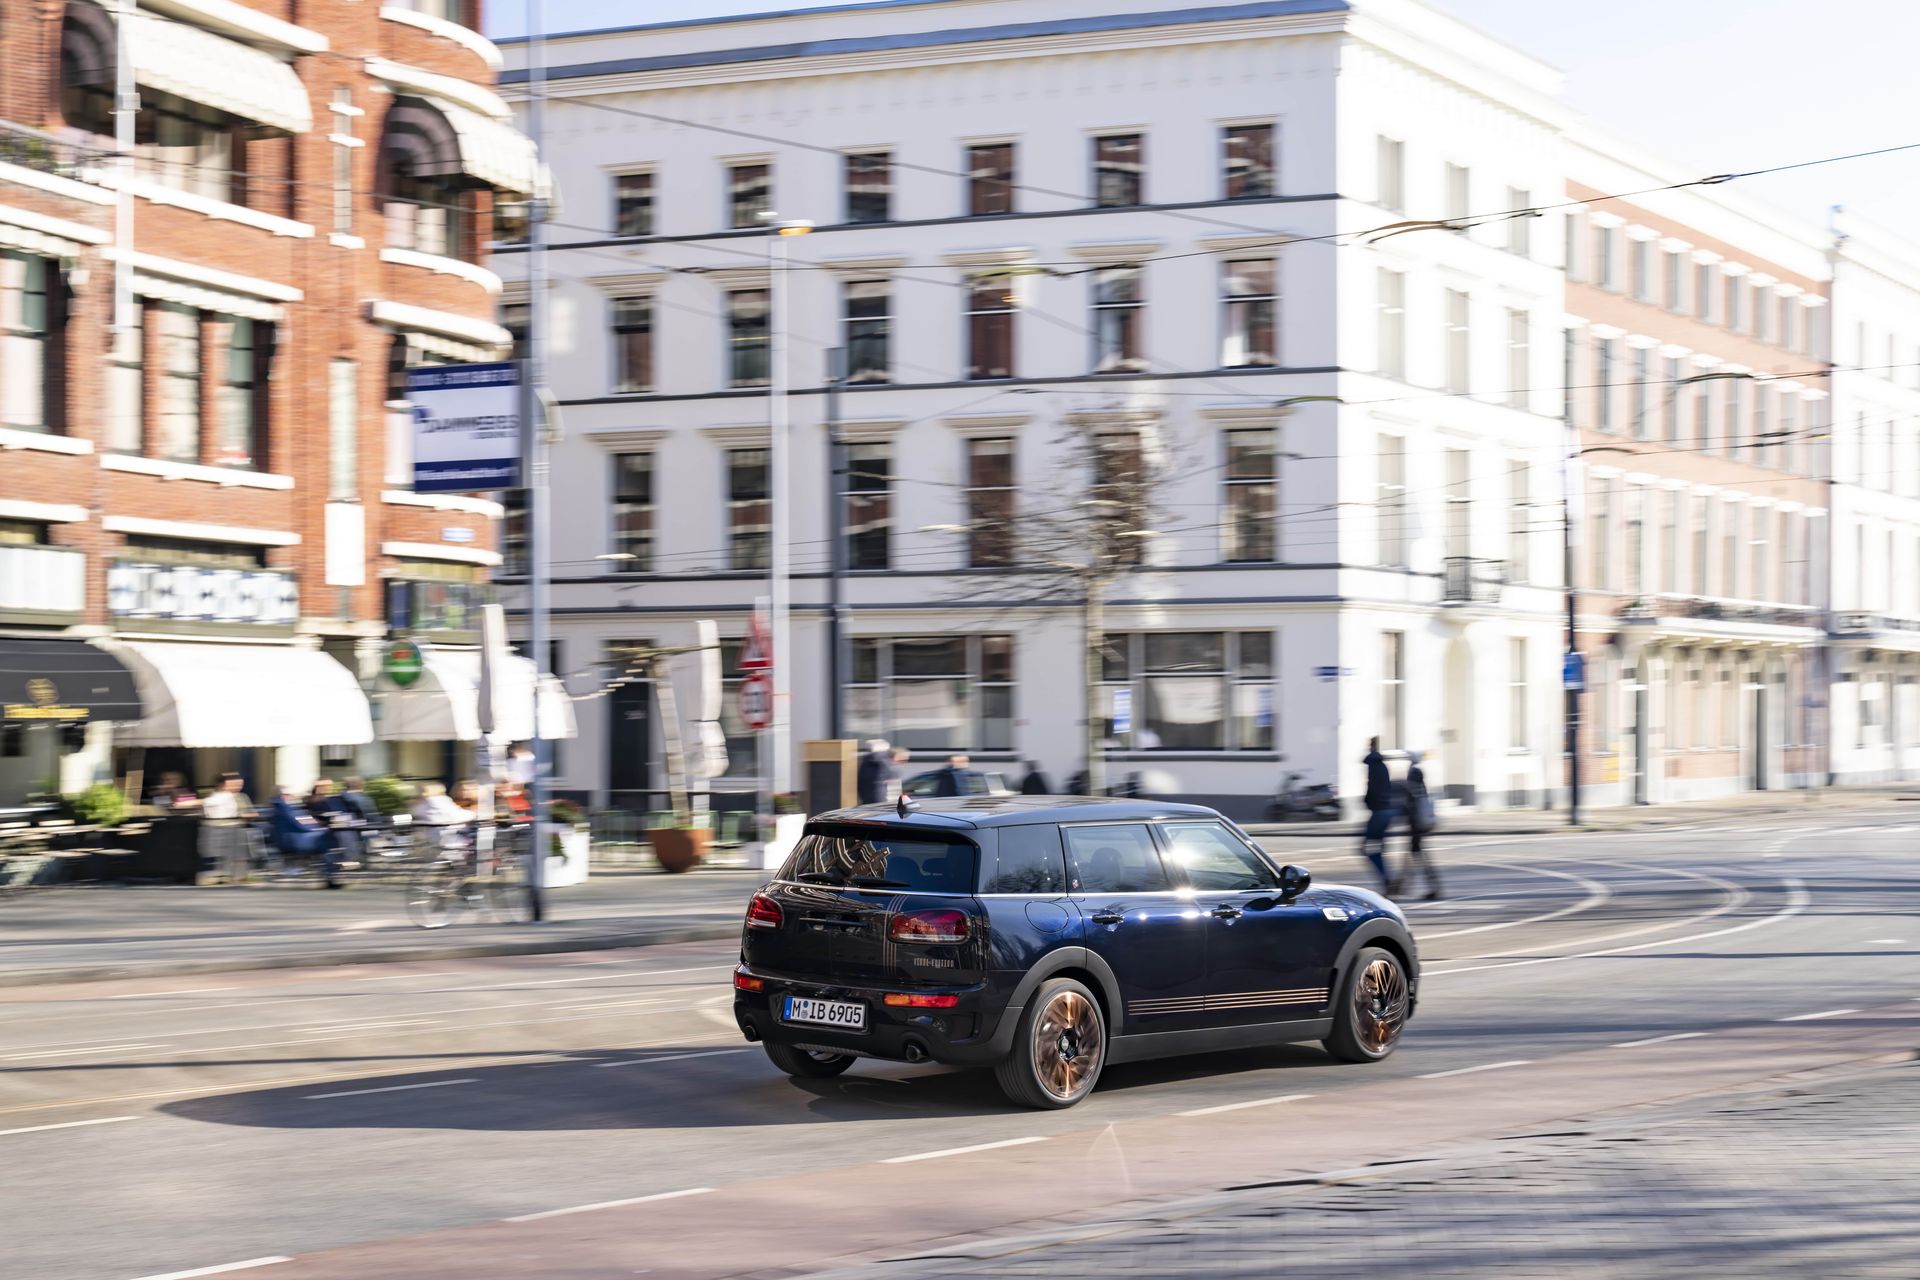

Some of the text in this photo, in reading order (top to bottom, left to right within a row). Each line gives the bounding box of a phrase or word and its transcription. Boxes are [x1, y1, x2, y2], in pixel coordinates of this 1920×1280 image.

[792, 1000, 862, 1024] M IB 6905
